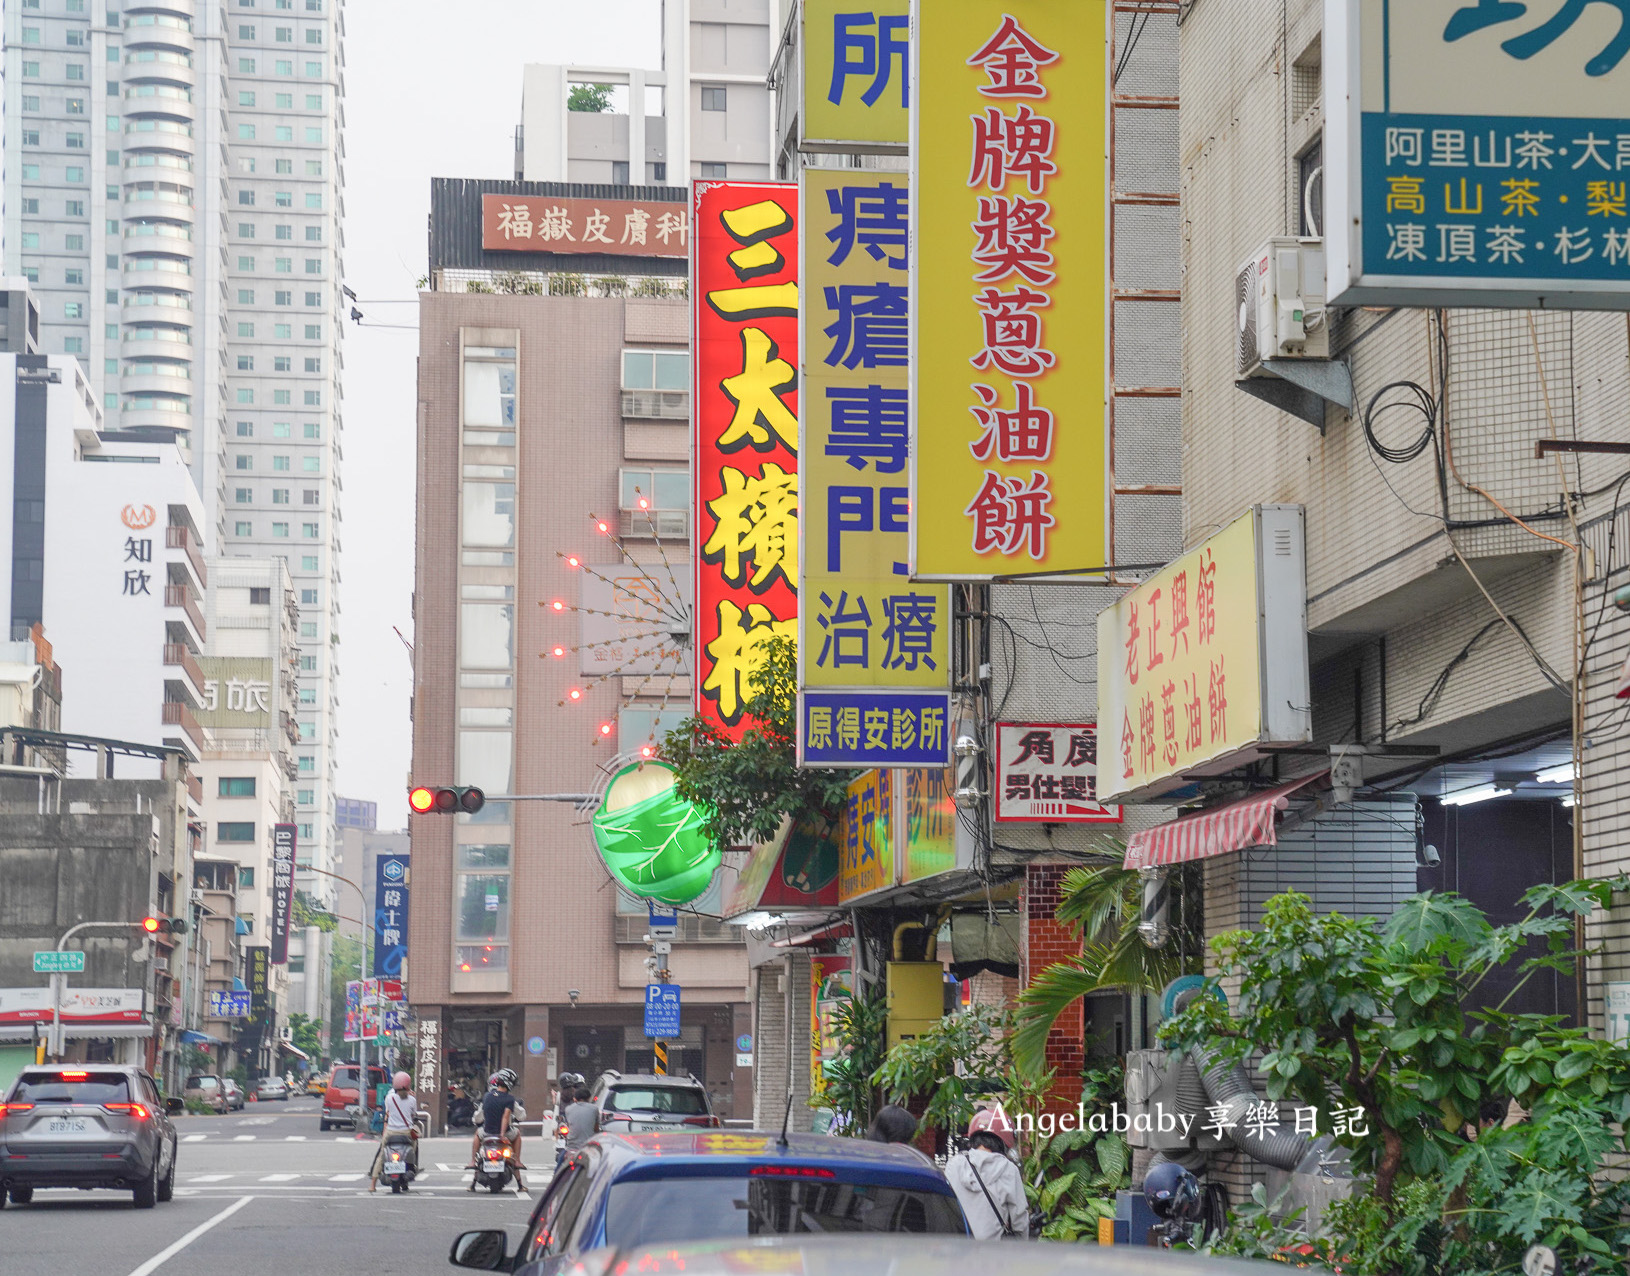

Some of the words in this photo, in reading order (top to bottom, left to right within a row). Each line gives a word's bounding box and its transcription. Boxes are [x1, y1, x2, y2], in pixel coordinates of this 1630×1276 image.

[496, 203, 688, 247] 福嶽皮膚科
[966, 15, 1058, 560] 金牌獎蔥油餅
[122, 536, 152, 596] 知欣
[1124, 547, 1216, 685] 老正興館
[807, 706, 944, 751] 原得安診所
[1120, 653, 1227, 779] 金牌蔥油餅
[1008, 730, 1096, 767] 角度
[276, 890, 287, 936] HOTEL
[649, 986, 661, 1002] P
